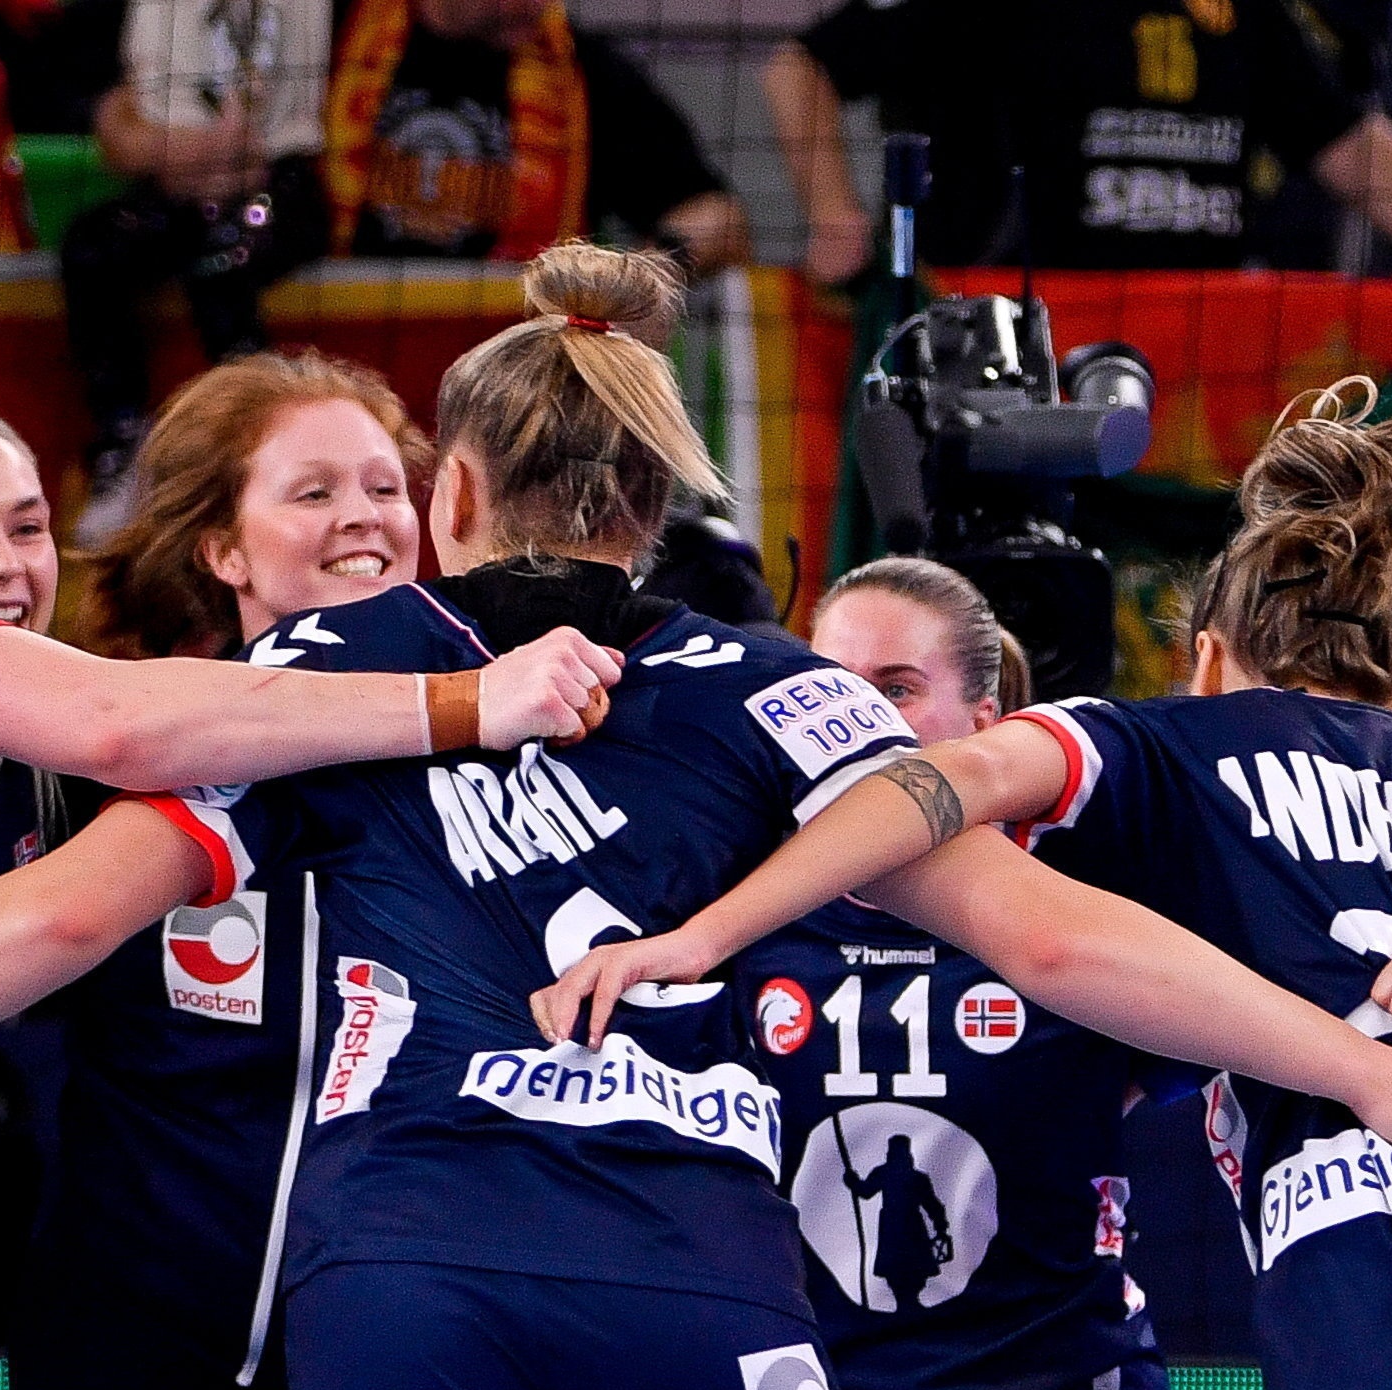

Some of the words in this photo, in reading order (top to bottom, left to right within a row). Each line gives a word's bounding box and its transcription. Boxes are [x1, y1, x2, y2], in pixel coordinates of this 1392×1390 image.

[805, 703, 895, 752] 1000
[862, 945, 936, 965] hummel
[173, 988, 257, 1016] posten
[820, 974, 948, 1098] 11
